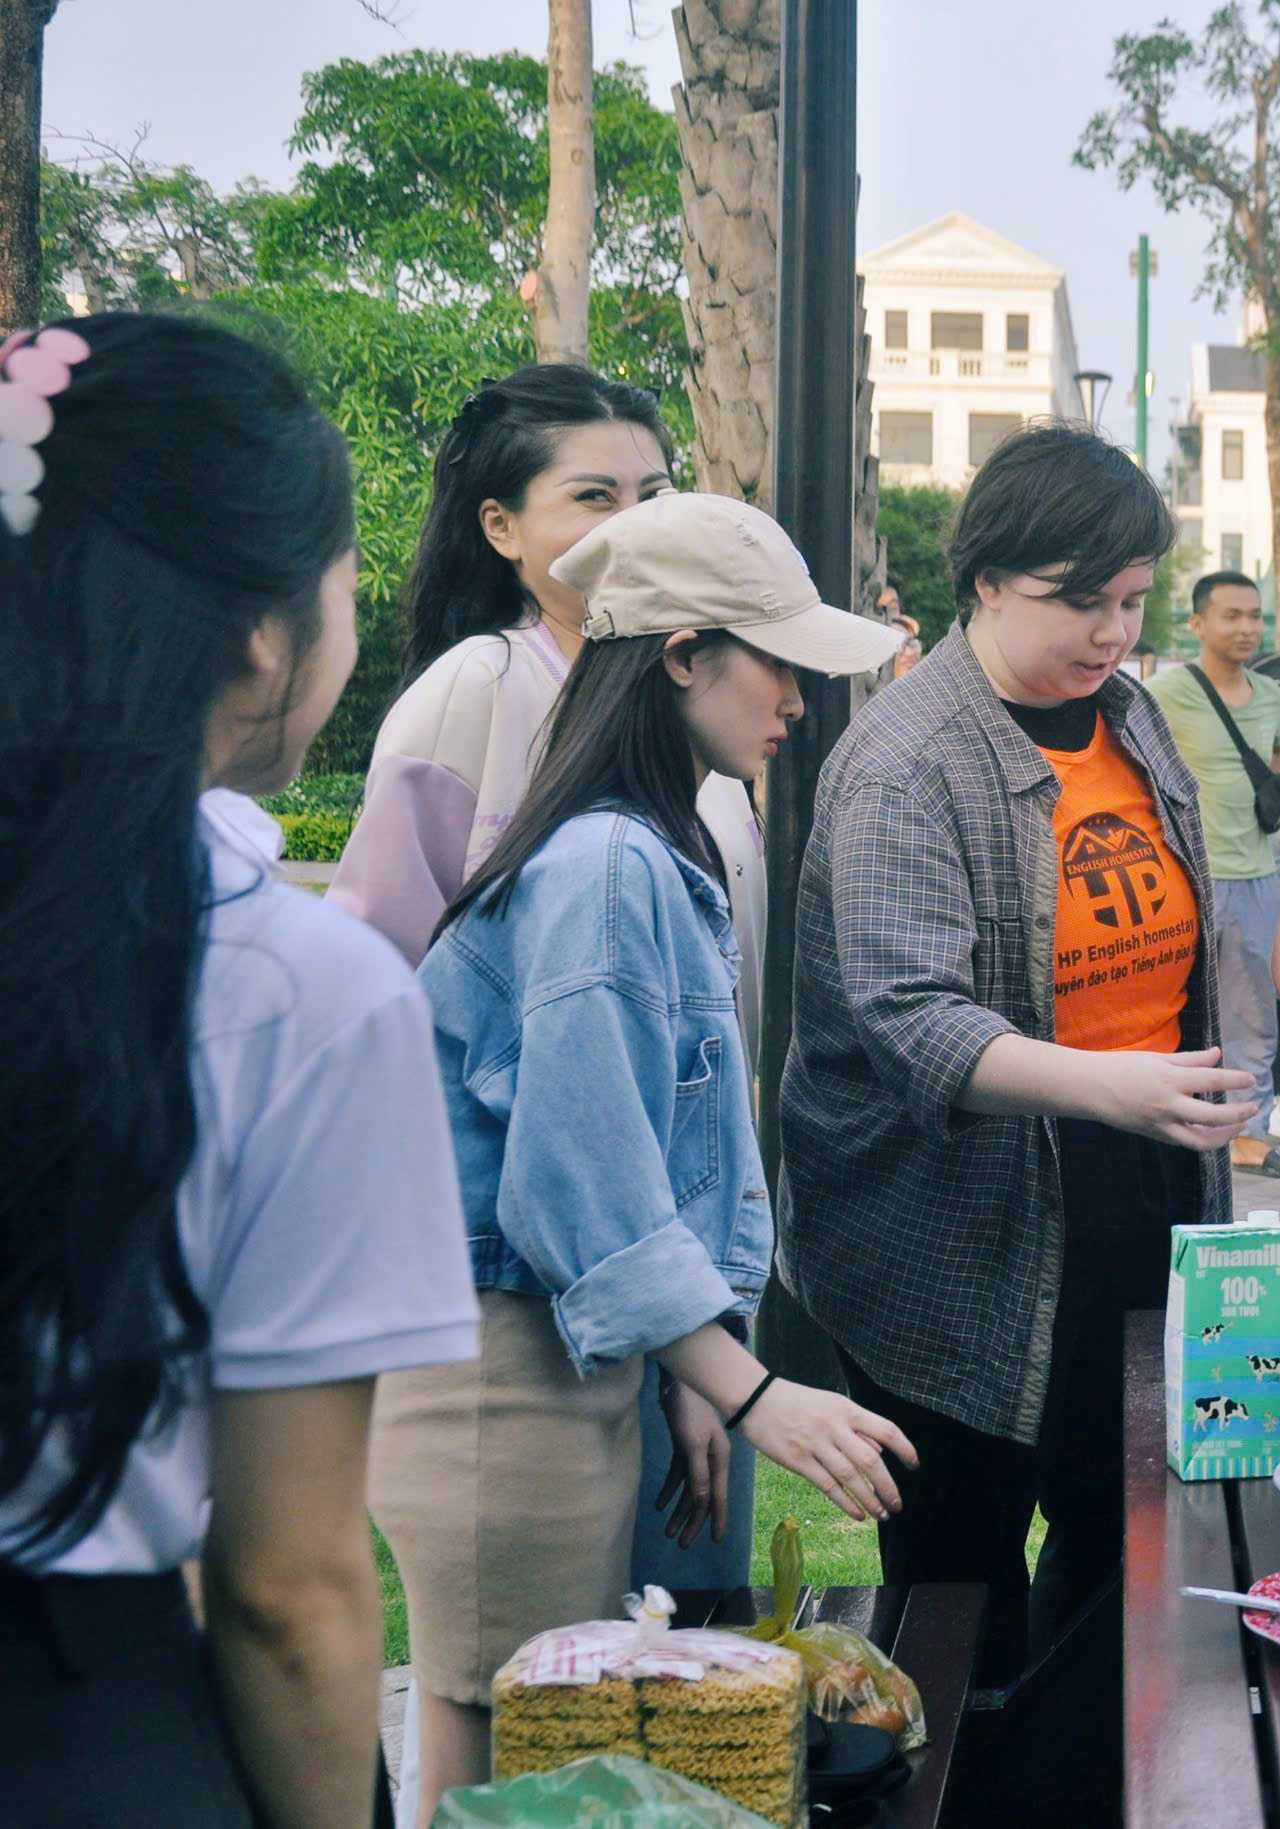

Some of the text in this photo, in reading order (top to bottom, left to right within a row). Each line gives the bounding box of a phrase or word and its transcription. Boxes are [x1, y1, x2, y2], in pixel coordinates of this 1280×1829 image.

[1067, 847, 1154, 875] ENGLISH HOMESTAY
[1068, 861, 1166, 928] HP
[1057, 918, 1194, 969] HP English homestay
[1054, 976, 1084, 996] uyên
[1088, 969, 1107, 987] đào
[1110, 964, 1128, 984] tạo
[1131, 953, 1155, 975] Tiếng
[1158, 948, 1173, 966] Anh
